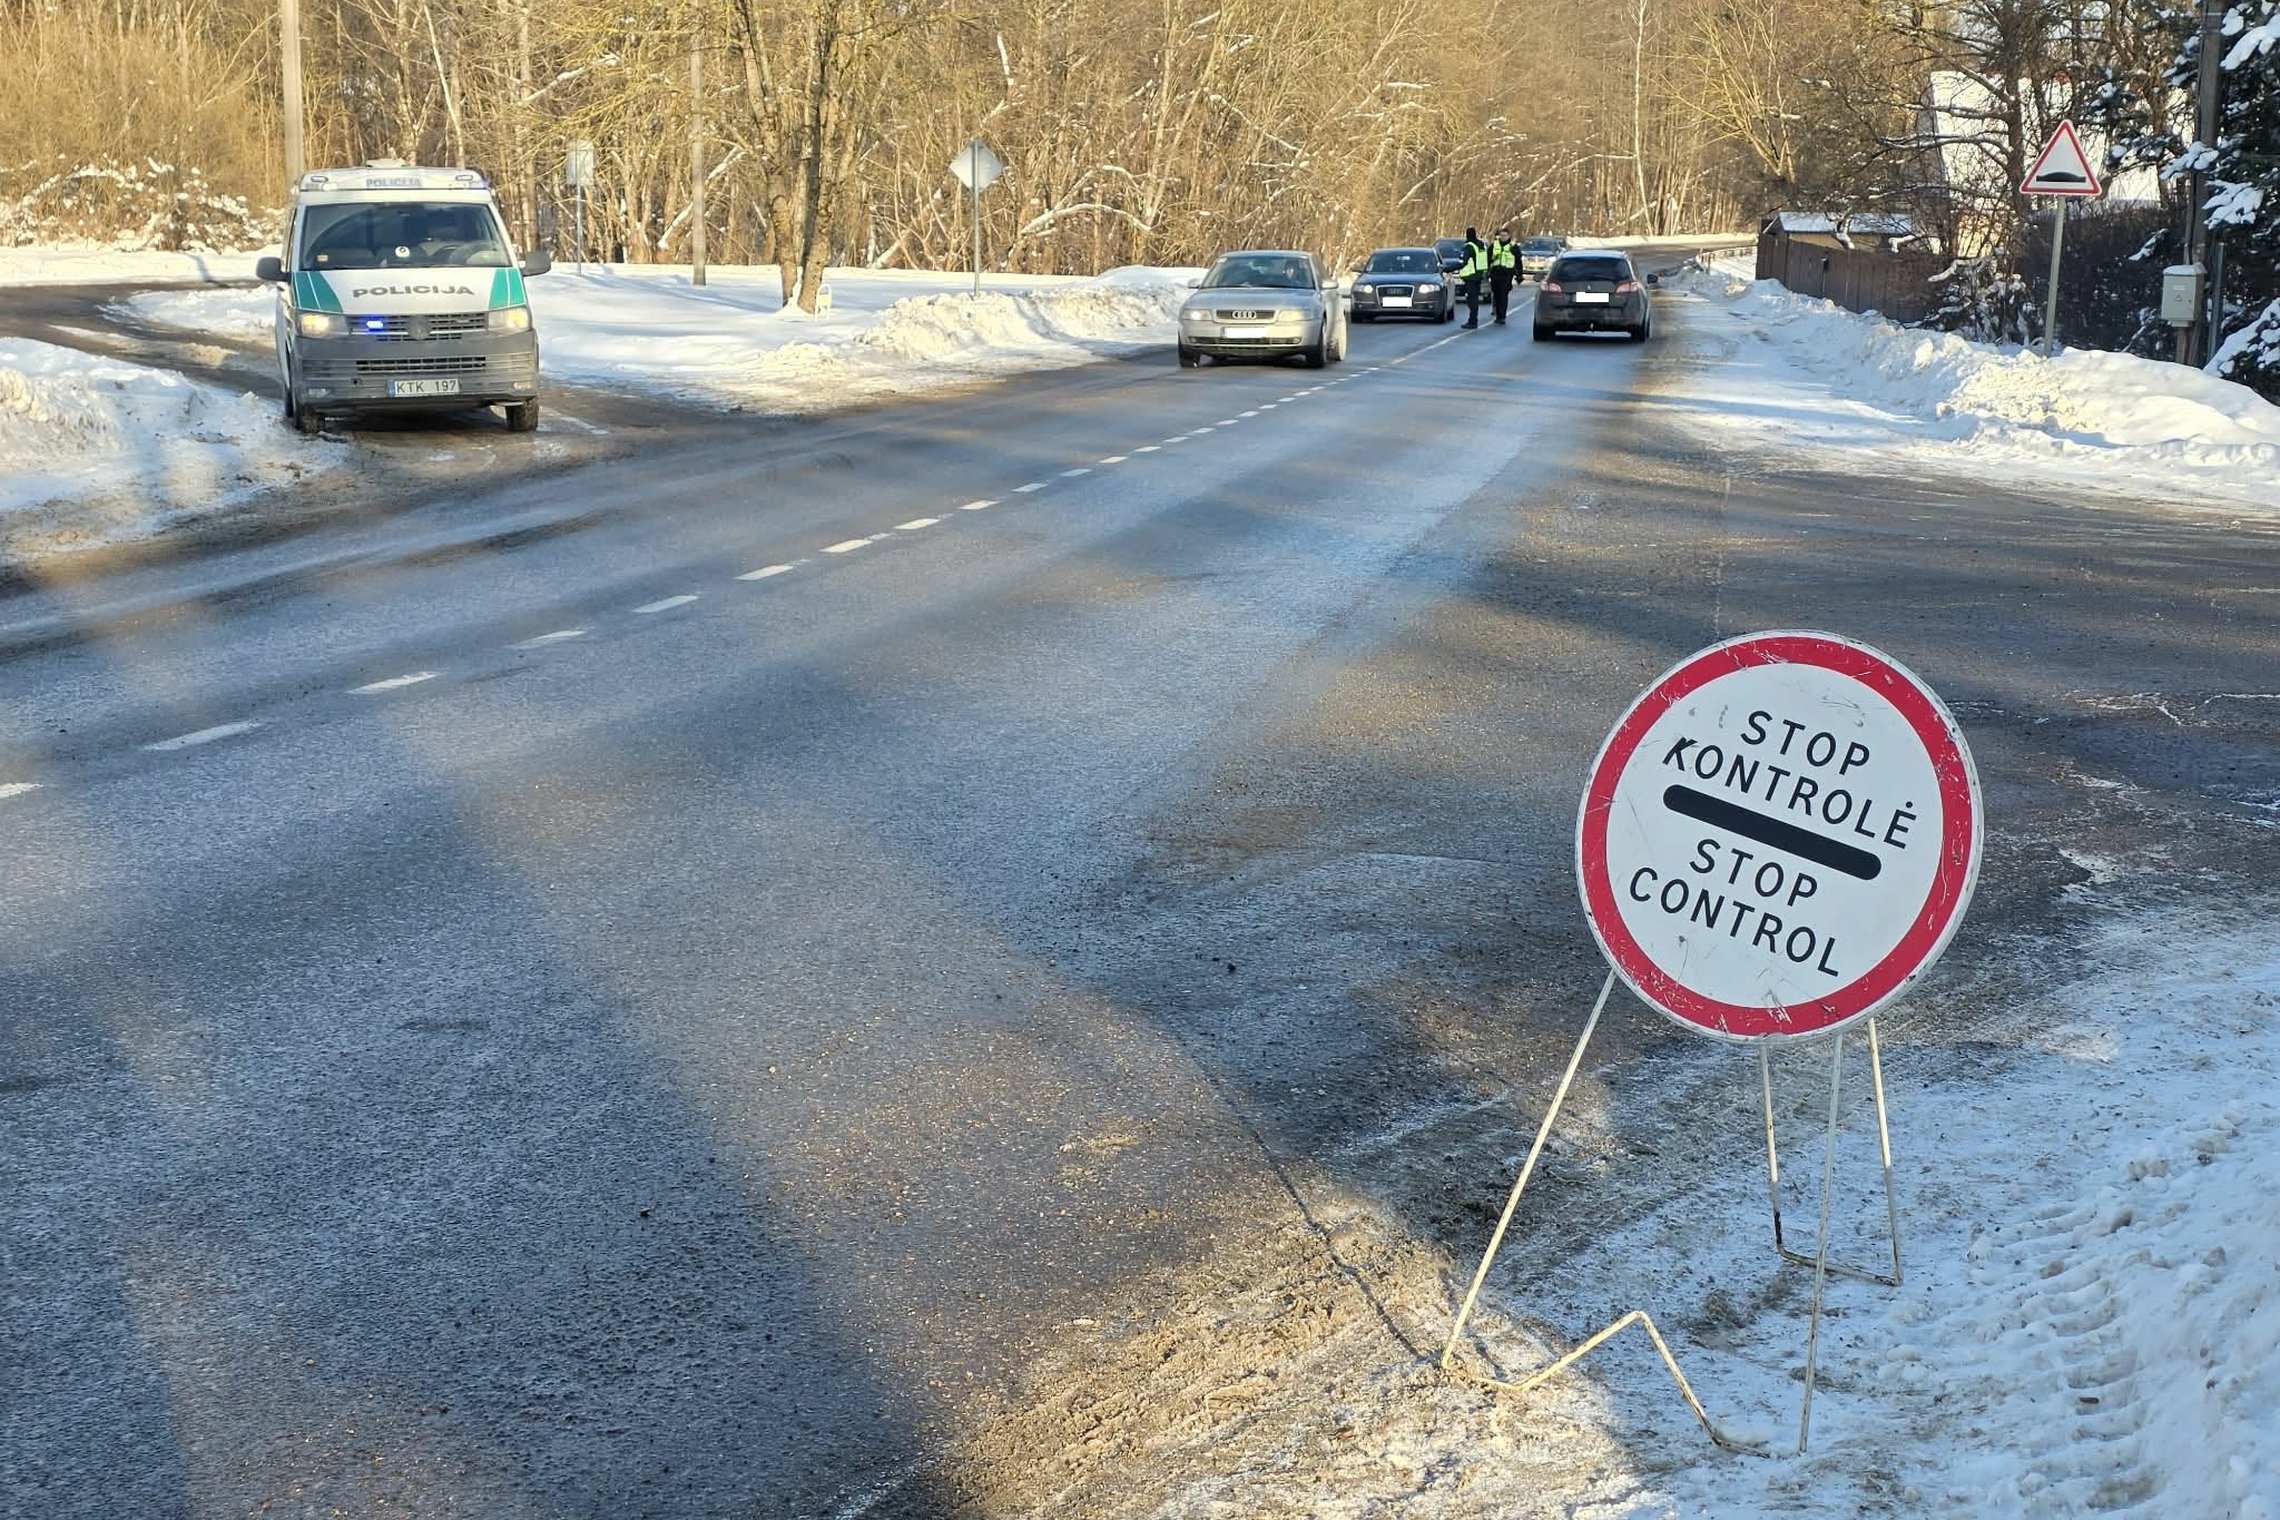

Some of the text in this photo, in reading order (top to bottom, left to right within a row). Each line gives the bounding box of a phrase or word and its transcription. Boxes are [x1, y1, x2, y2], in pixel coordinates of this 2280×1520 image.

[366, 178, 422, 188] POLICIJA
[352, 285, 474, 298] POLICIJA
[396, 381, 425, 393] KTK
[435, 380, 456, 392] 197
[1740, 710, 1870, 775] STOP
[1662, 736, 1917, 849] KONTROLĖ
[1689, 838, 1818, 907] STOP
[1629, 866, 1840, 977] CONTROL
